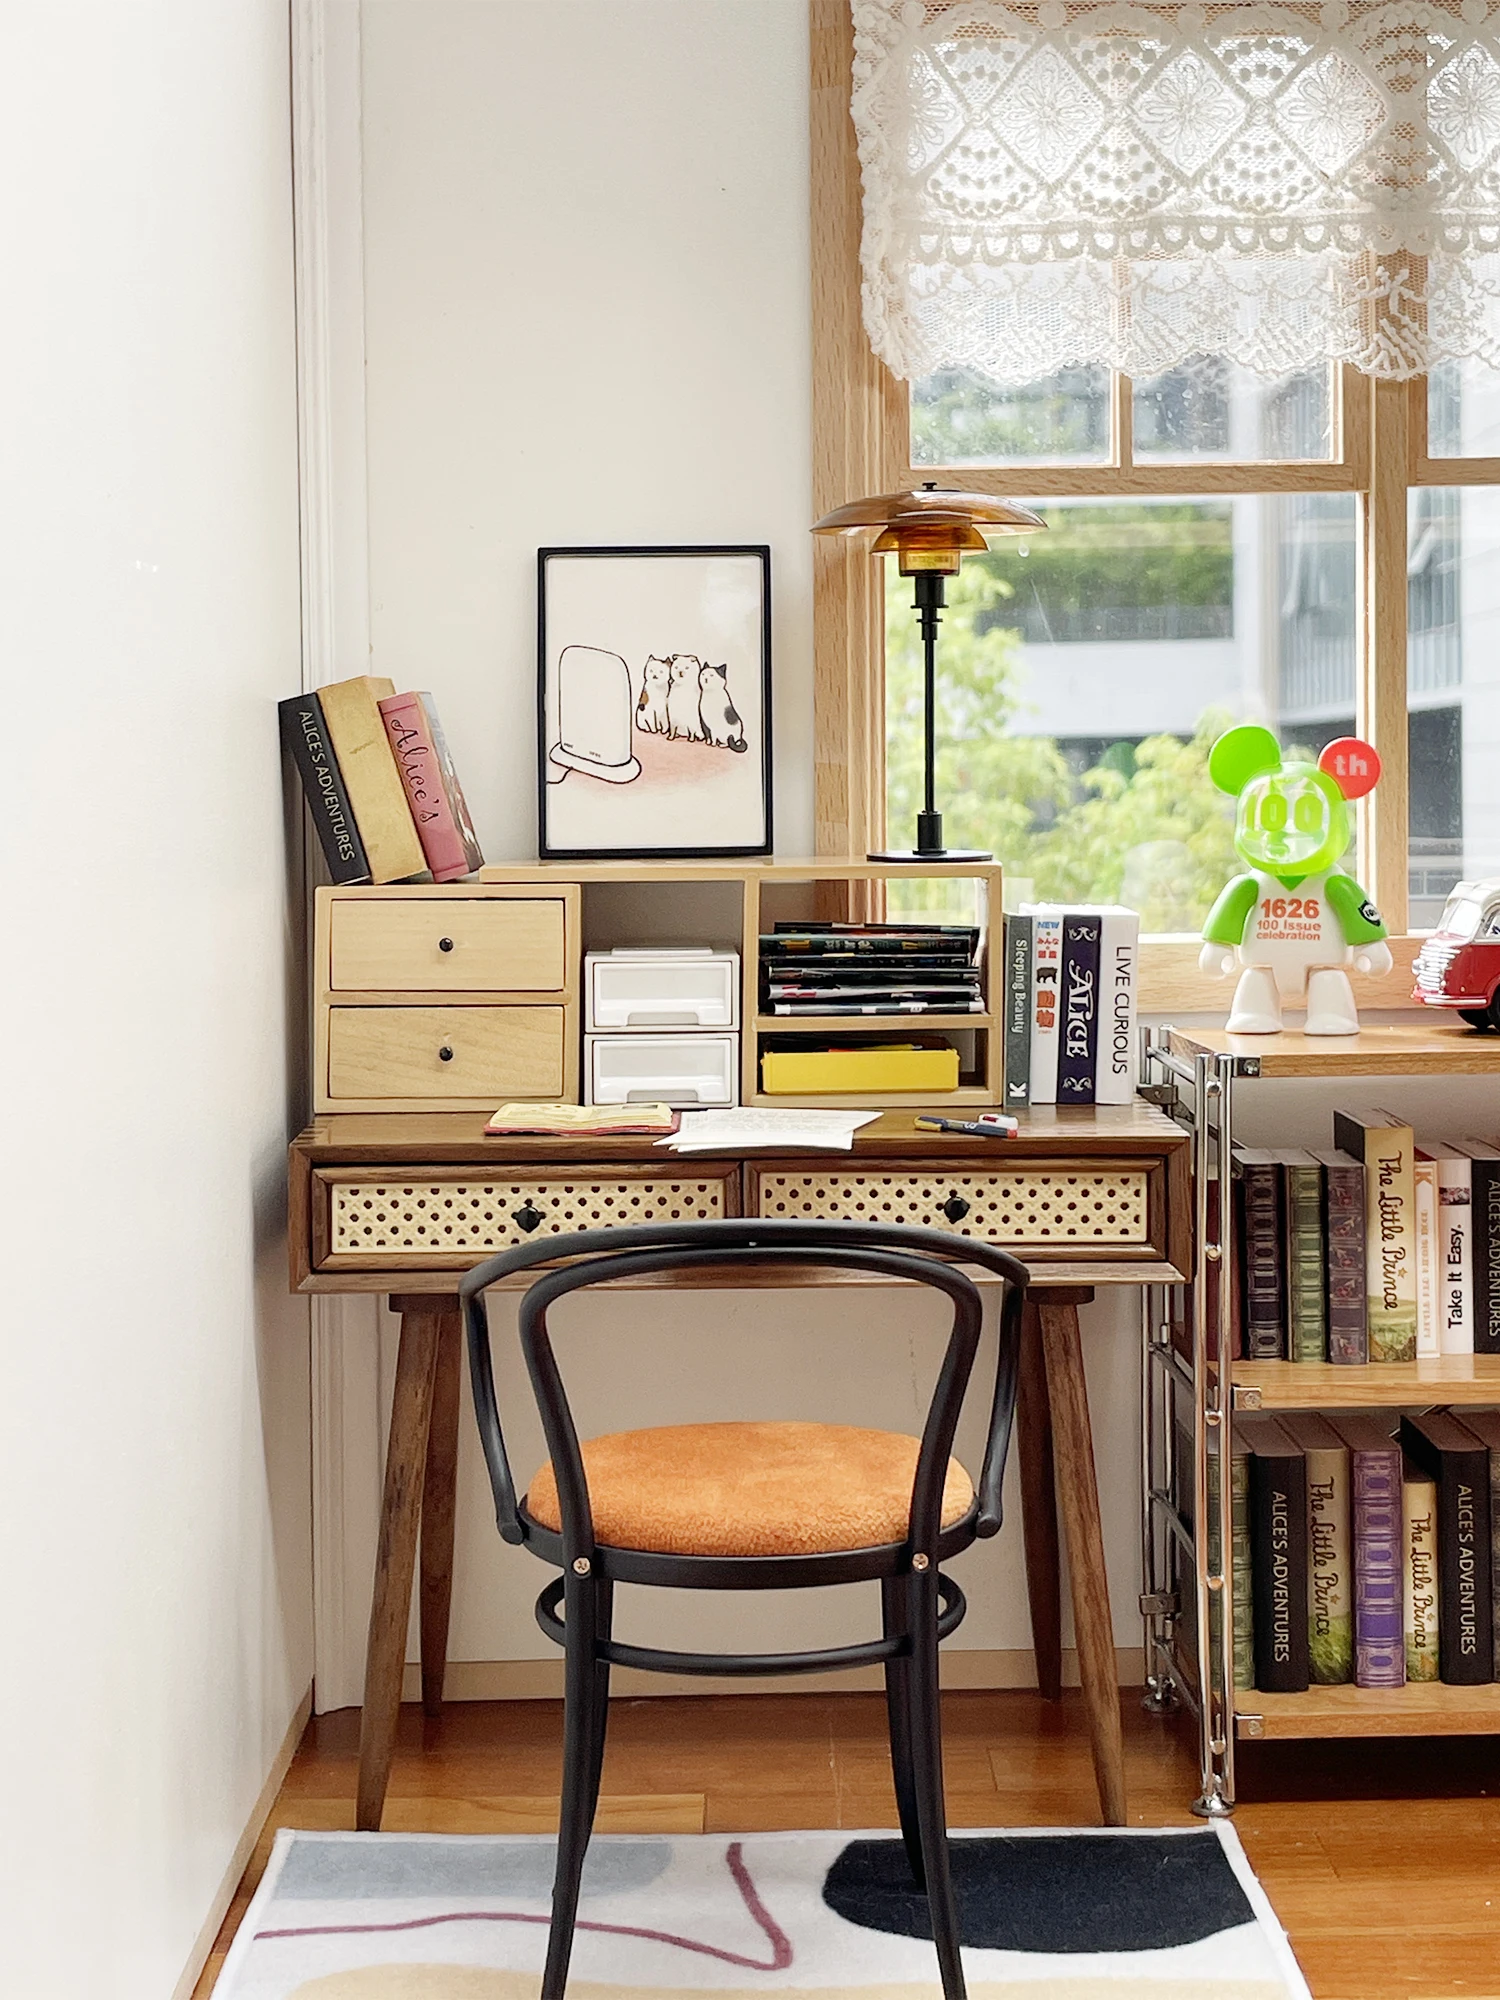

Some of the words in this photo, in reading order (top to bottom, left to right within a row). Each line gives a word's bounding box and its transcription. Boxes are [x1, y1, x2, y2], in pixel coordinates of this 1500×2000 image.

[299, 711, 326, 763] ALICE'S
[315, 766, 356, 862] ADVENTURES
[390, 719, 440, 823] Alice's
[1334, 753, 1368, 776] th
[1037, 921, 1060, 929] NEW
[1257, 919, 1279, 930] 100
[1284, 919, 1321, 931] Issue
[1260, 897, 1320, 918] 1626
[1256, 931, 1321, 941] celebration
[1011, 939, 1028, 991] Sleeping
[1115, 946, 1132, 987] LIVE
[1010, 992, 1027, 1034] Beauty
[1112, 993, 1130, 1074] CURIOUS
[1378, 1150, 1402, 1187] The
[1377, 1190, 1404, 1242] Little
[1447, 1224, 1465, 1265] Easy.
[1382, 1246, 1407, 1310] Prince
[1448, 1271, 1462, 1283] It
[1488, 1237, 1500, 1337] ADVENTURES
[1447, 1290, 1462, 1329] Take
[1310, 1476, 1334, 1512] The
[1458, 1484, 1474, 1543] ALICE'S
[1272, 1491, 1288, 1550] ALICE'S
[1310, 1514, 1336, 1568] Little
[1410, 1512, 1431, 1543] The
[1411, 1546, 1433, 1592] Little
[1272, 1553, 1290, 1662] ADVENTURES
[1315, 1573, 1339, 1636] Prince
[1413, 1594, 1434, 1649] Prince
[1459, 1546, 1477, 1654] ADVENTURES
